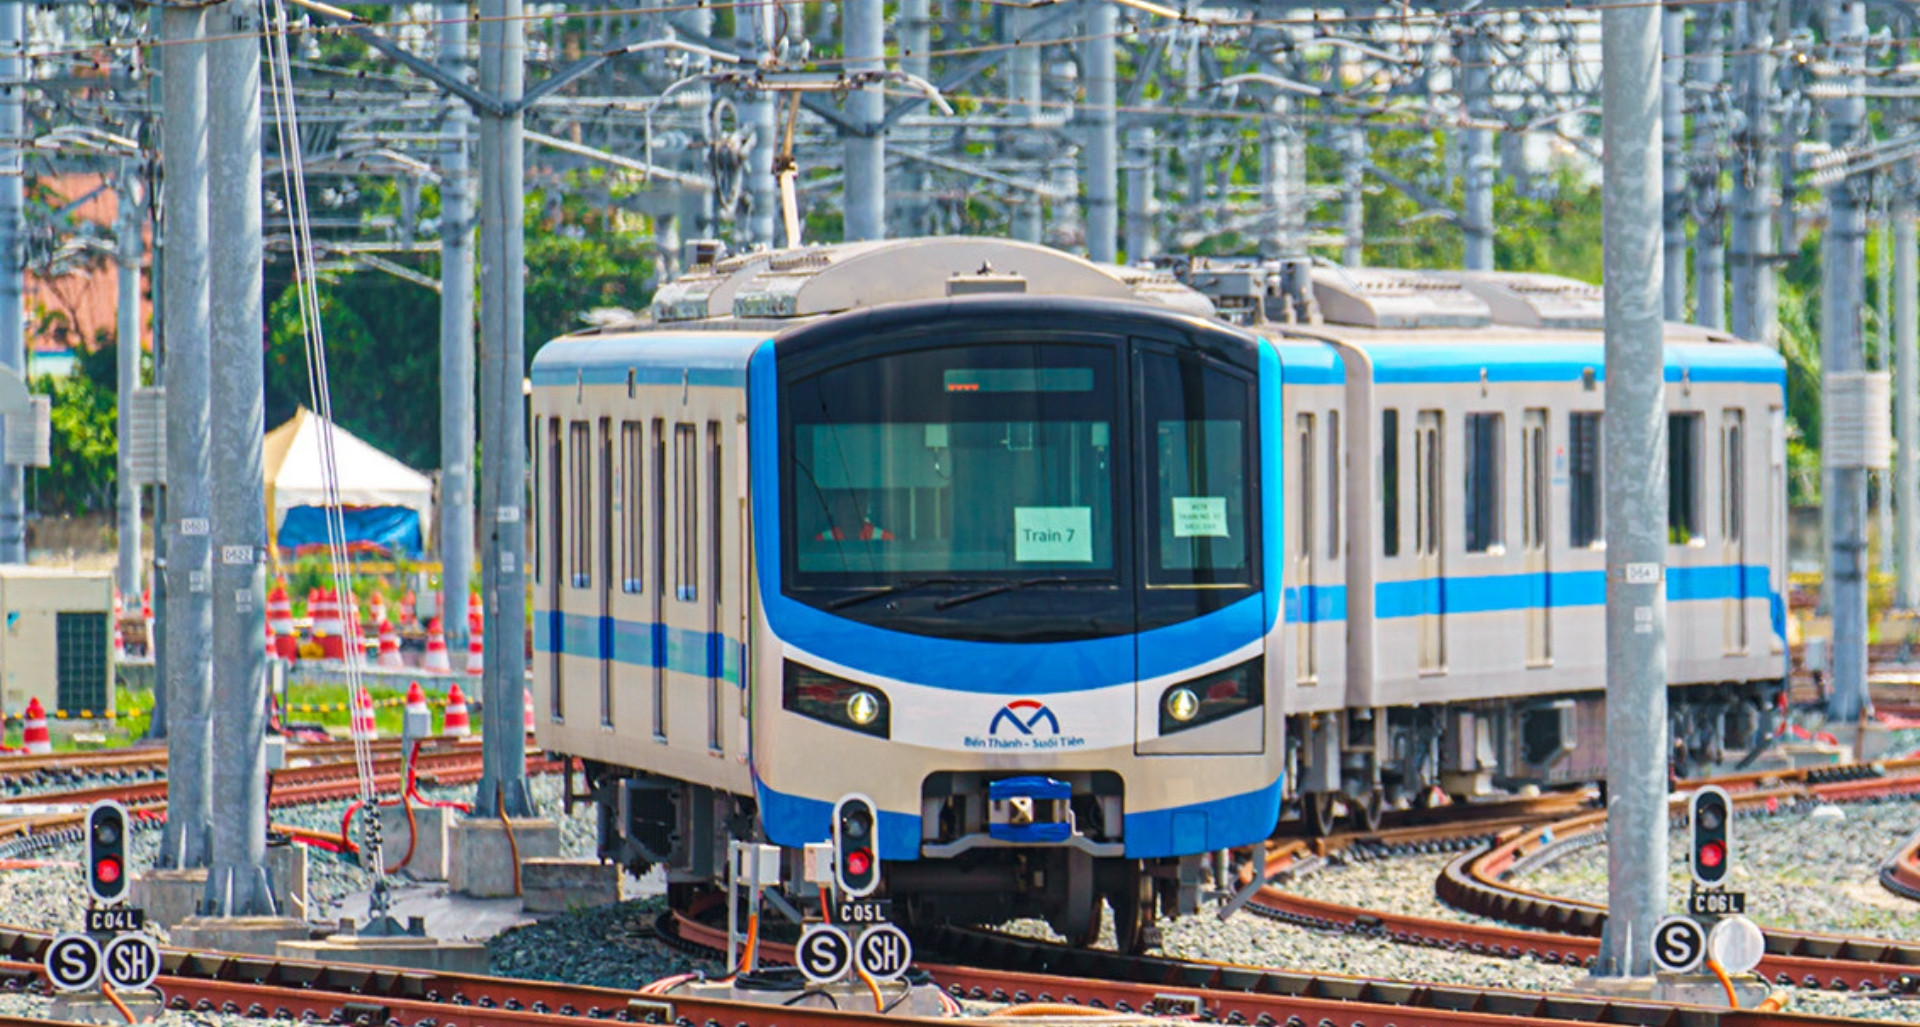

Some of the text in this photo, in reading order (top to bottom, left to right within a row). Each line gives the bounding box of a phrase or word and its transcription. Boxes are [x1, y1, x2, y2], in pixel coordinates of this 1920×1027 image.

[1023, 528, 1075, 543] Train 7
[988, 738, 1022, 749] Thành
[91, 911, 137, 930] C04L
[841, 904, 886, 922] C05L
[60, 943, 87, 981] S
[811, 935, 837, 972] S
[867, 935, 900, 972] SH
[1664, 926, 1691, 962] S
[114, 944, 148, 981] SH
